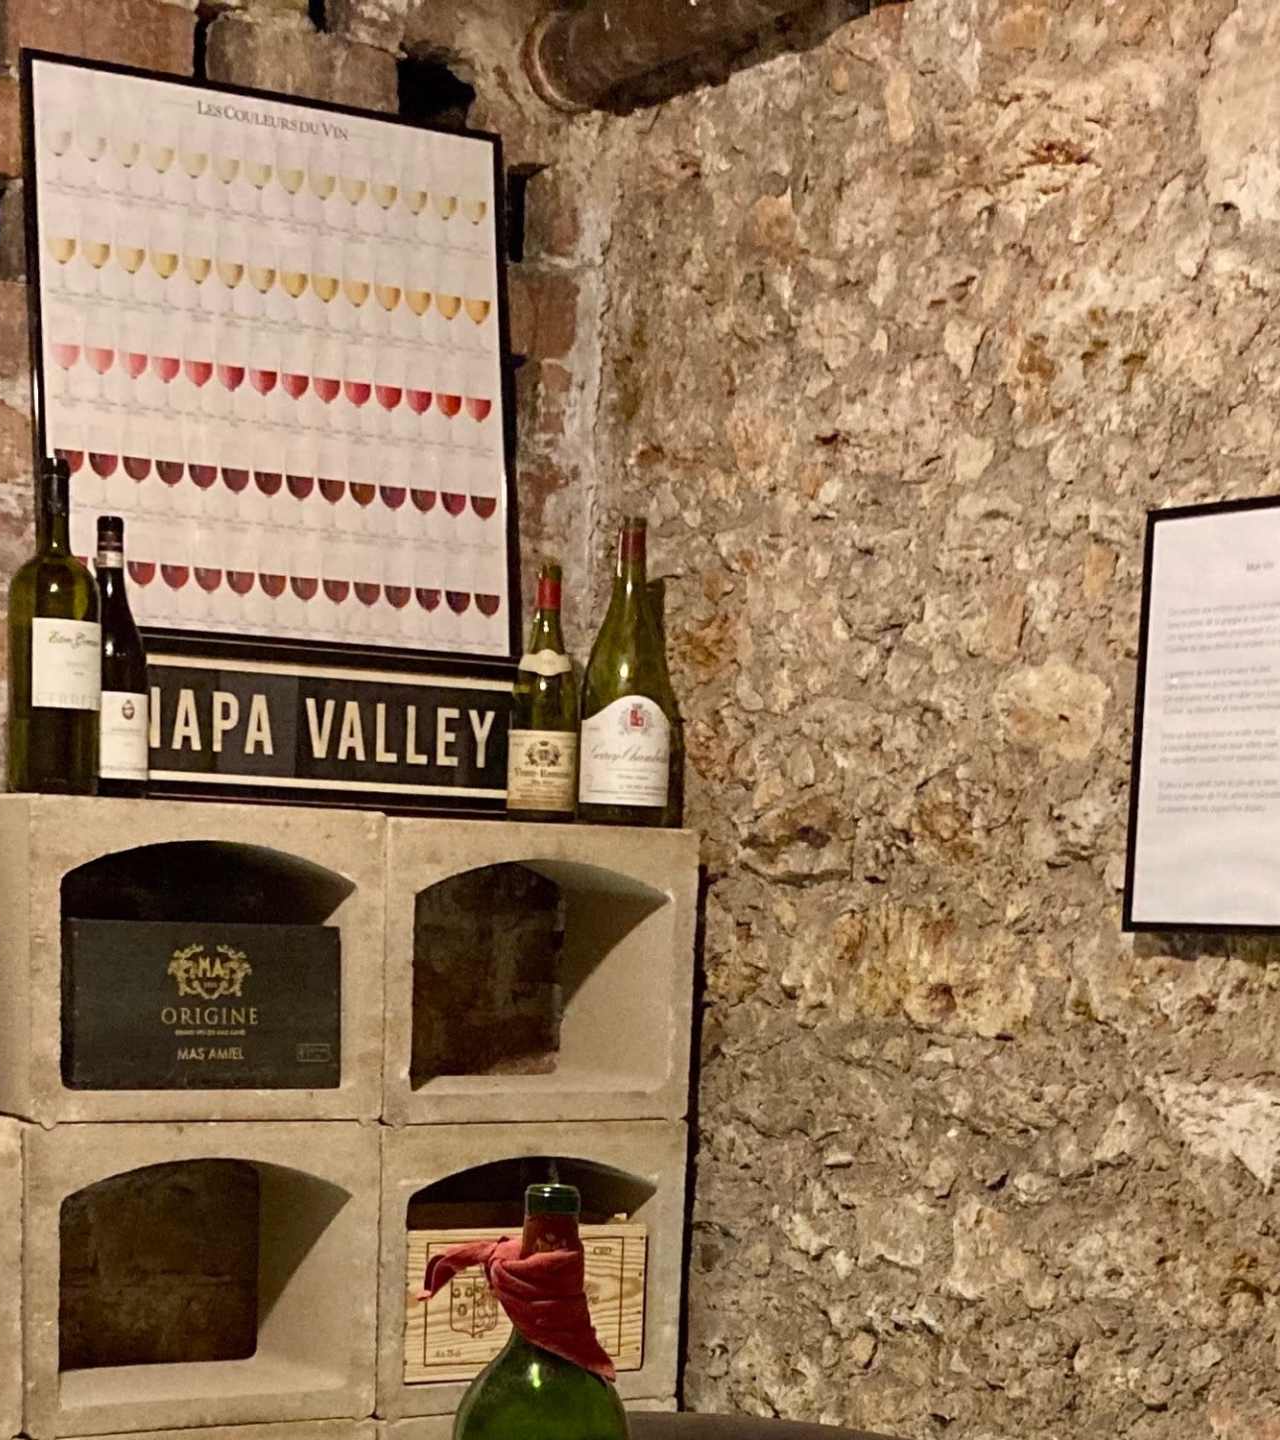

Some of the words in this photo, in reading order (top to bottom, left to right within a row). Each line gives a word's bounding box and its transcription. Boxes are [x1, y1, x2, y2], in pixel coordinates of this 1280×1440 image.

[197, 100, 223, 116] LES
[224, 105, 298, 131] COULEURS
[299, 121, 319, 135] DU
[322, 122, 349, 140] VIN
[305, 697, 496, 769] VALLEY
[160, 1007, 259, 1026] ORIGINE
[176, 1047, 206, 1061] MAS
[207, 1047, 246, 1060] AMIEL
